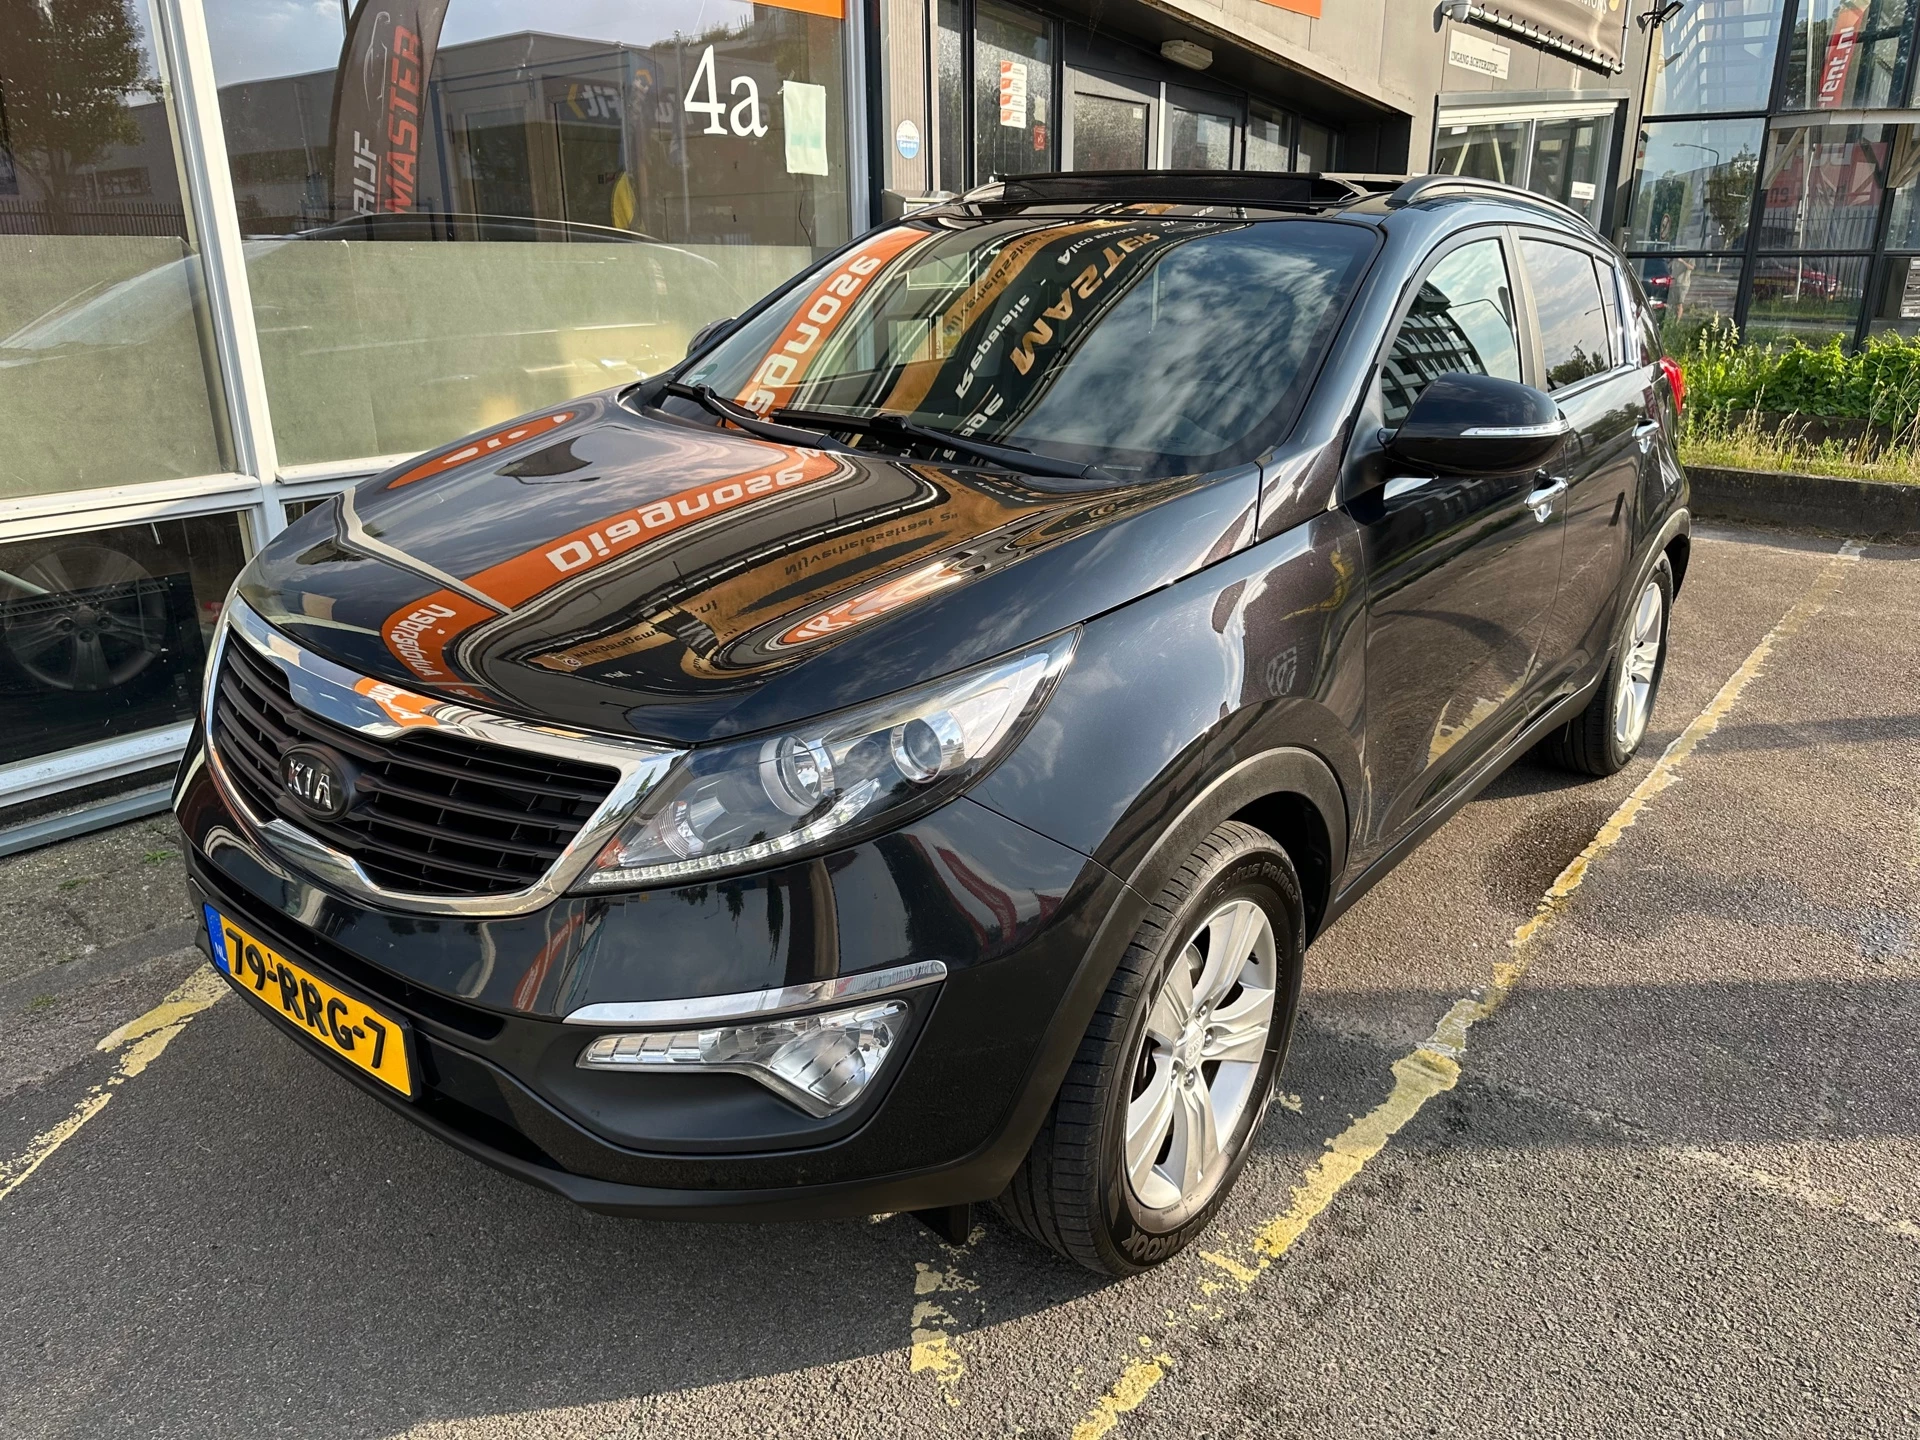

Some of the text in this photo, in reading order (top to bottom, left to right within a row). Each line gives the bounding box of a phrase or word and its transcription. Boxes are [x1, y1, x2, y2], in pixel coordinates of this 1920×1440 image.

[684, 45, 768, 137] 4a
[287, 757, 333, 810] KIA
[214, 941, 227, 962] NL
[226, 927, 386, 1070] 79-RRG-7
